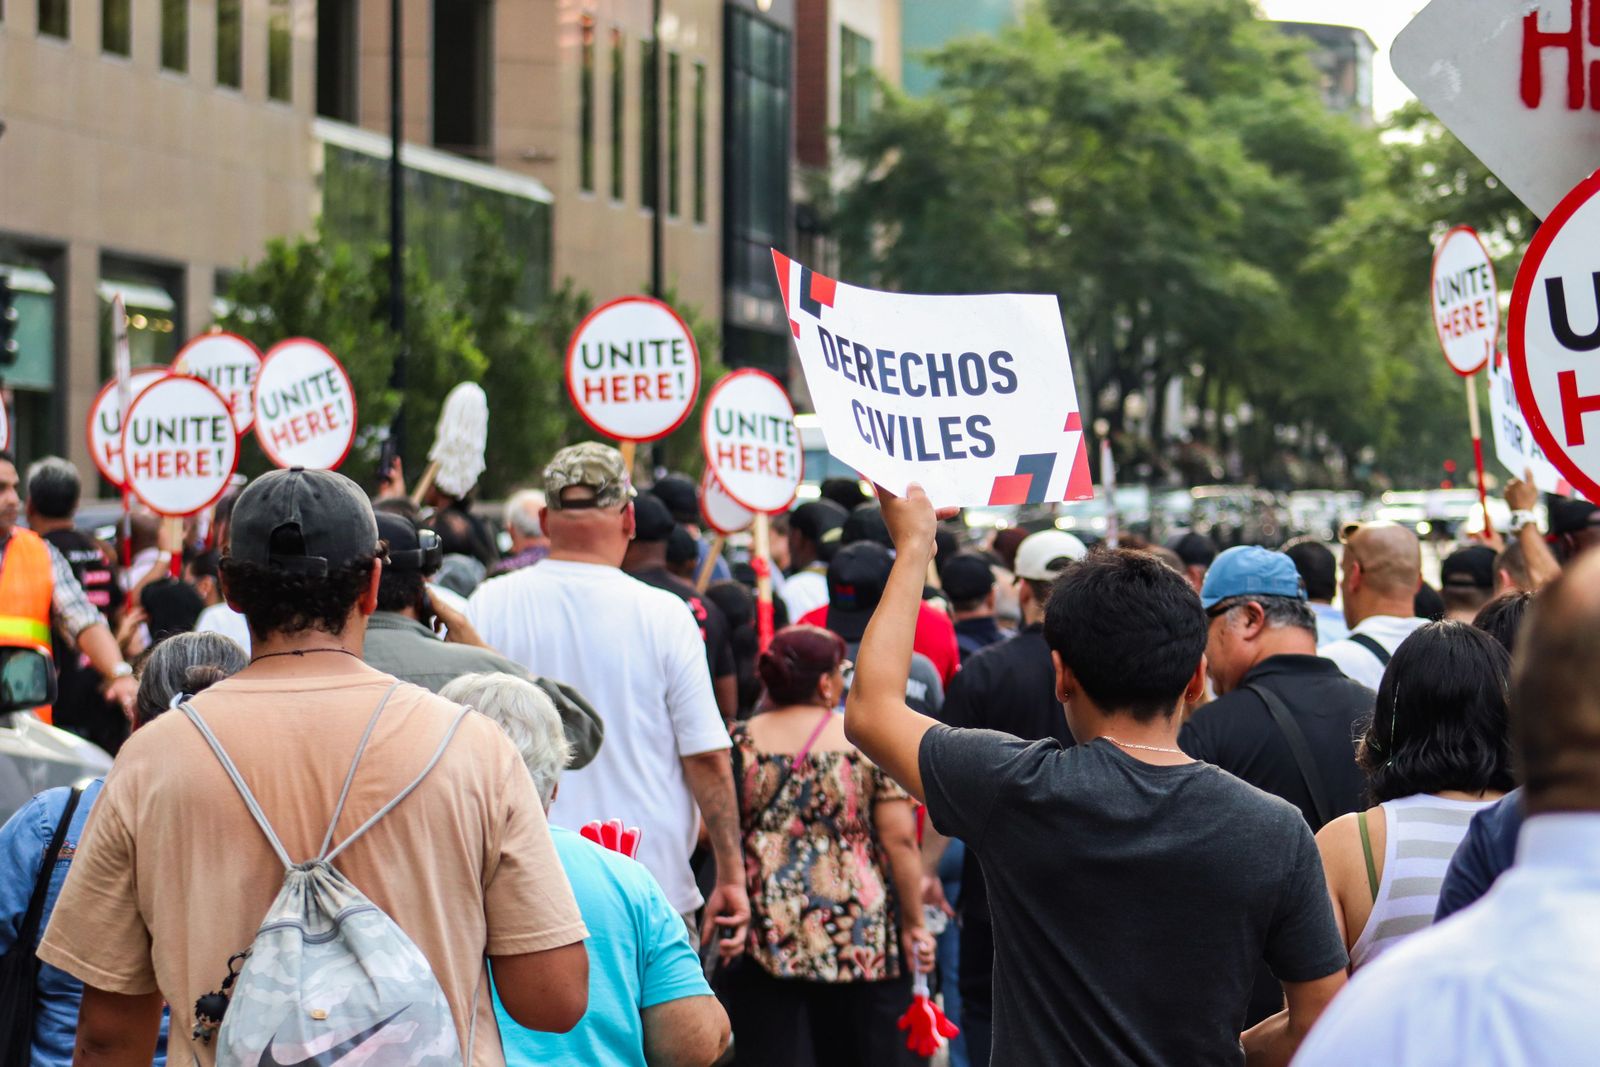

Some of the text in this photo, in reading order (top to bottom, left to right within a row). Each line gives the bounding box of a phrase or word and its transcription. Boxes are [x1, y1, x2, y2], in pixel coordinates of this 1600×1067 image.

[1437, 263, 1490, 307] UNITE
[1441, 297, 1494, 340] HERE!
[582, 339, 685, 370] UNITE
[817, 325, 1018, 398] DERECHOS
[189, 364, 256, 386] NITE
[261, 367, 342, 420] UNITE
[584, 372, 685, 404] HERE!
[132, 415, 227, 446] UNITE
[270, 399, 350, 452] HERE!
[715, 408, 796, 446] UNITE
[851, 398, 995, 462] CIVILES
[133, 448, 225, 480] HERE!
[717, 442, 796, 481] HERE!
